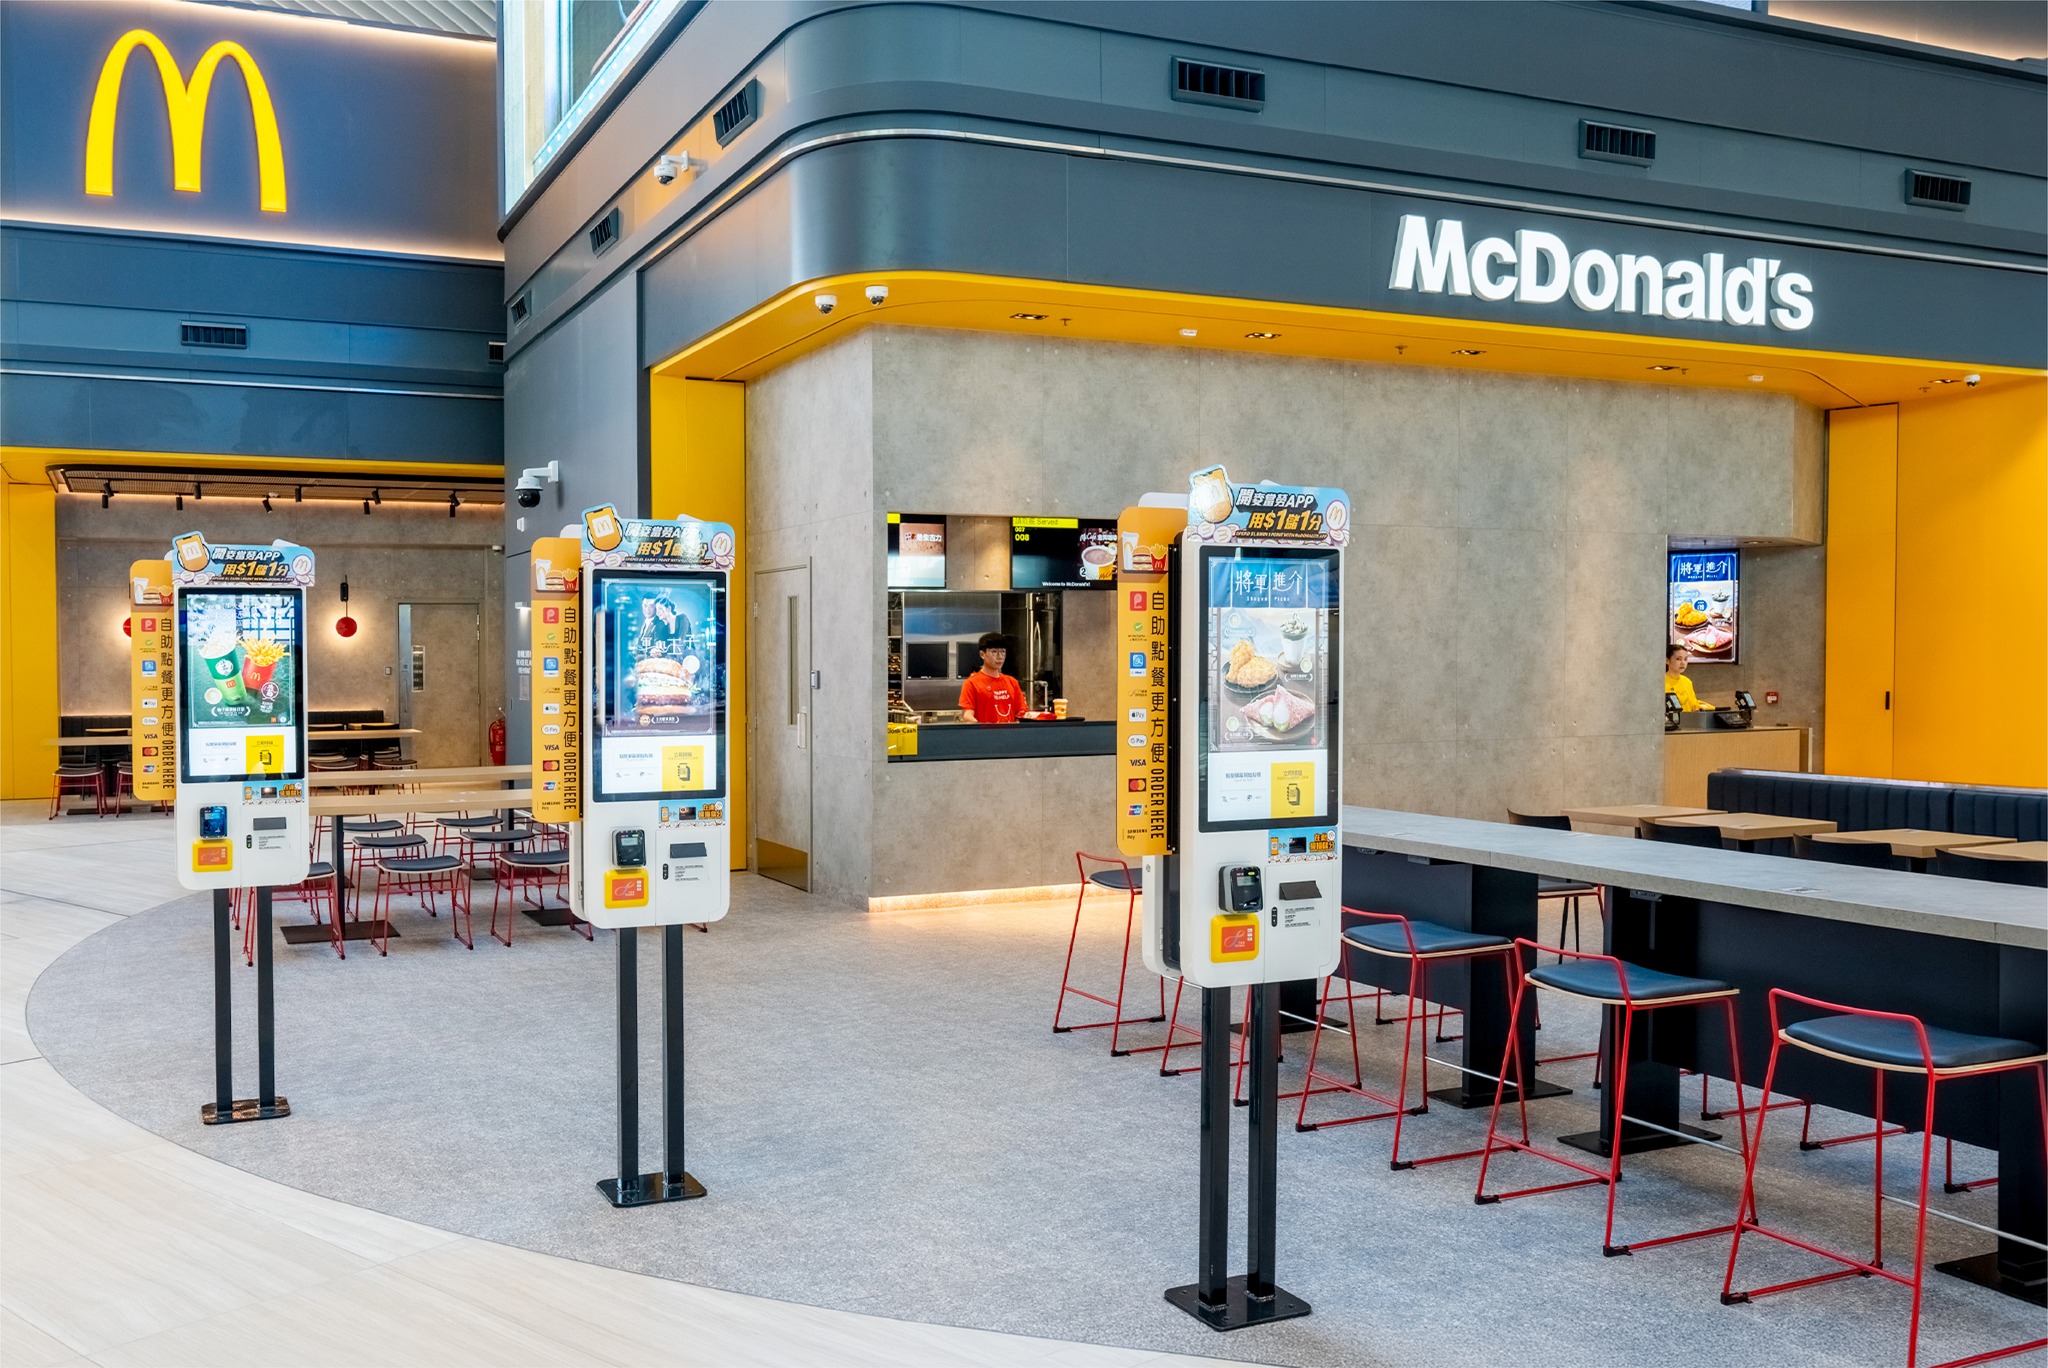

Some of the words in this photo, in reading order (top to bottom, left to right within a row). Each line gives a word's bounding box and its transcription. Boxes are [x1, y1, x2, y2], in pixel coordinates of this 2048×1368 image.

[1389, 213, 1813, 331] McDonald's
[1235, 570, 1303, 595] 將軍推介
[160, 618, 174, 737] 自助點餐更方便
[563, 607, 577, 748] 自助點餐更方便
[1151, 591, 1166, 763] 自助點餐更方便
[162, 740, 174, 766] ORDER
[563, 752, 577, 784] ORDER
[1130, 759, 1147, 767] VISA
[162, 768, 175, 789] HERE
[1150, 768, 1165, 806] ORDER
[563, 786, 577, 810] HERE
[1150, 810, 1165, 839] HERE
